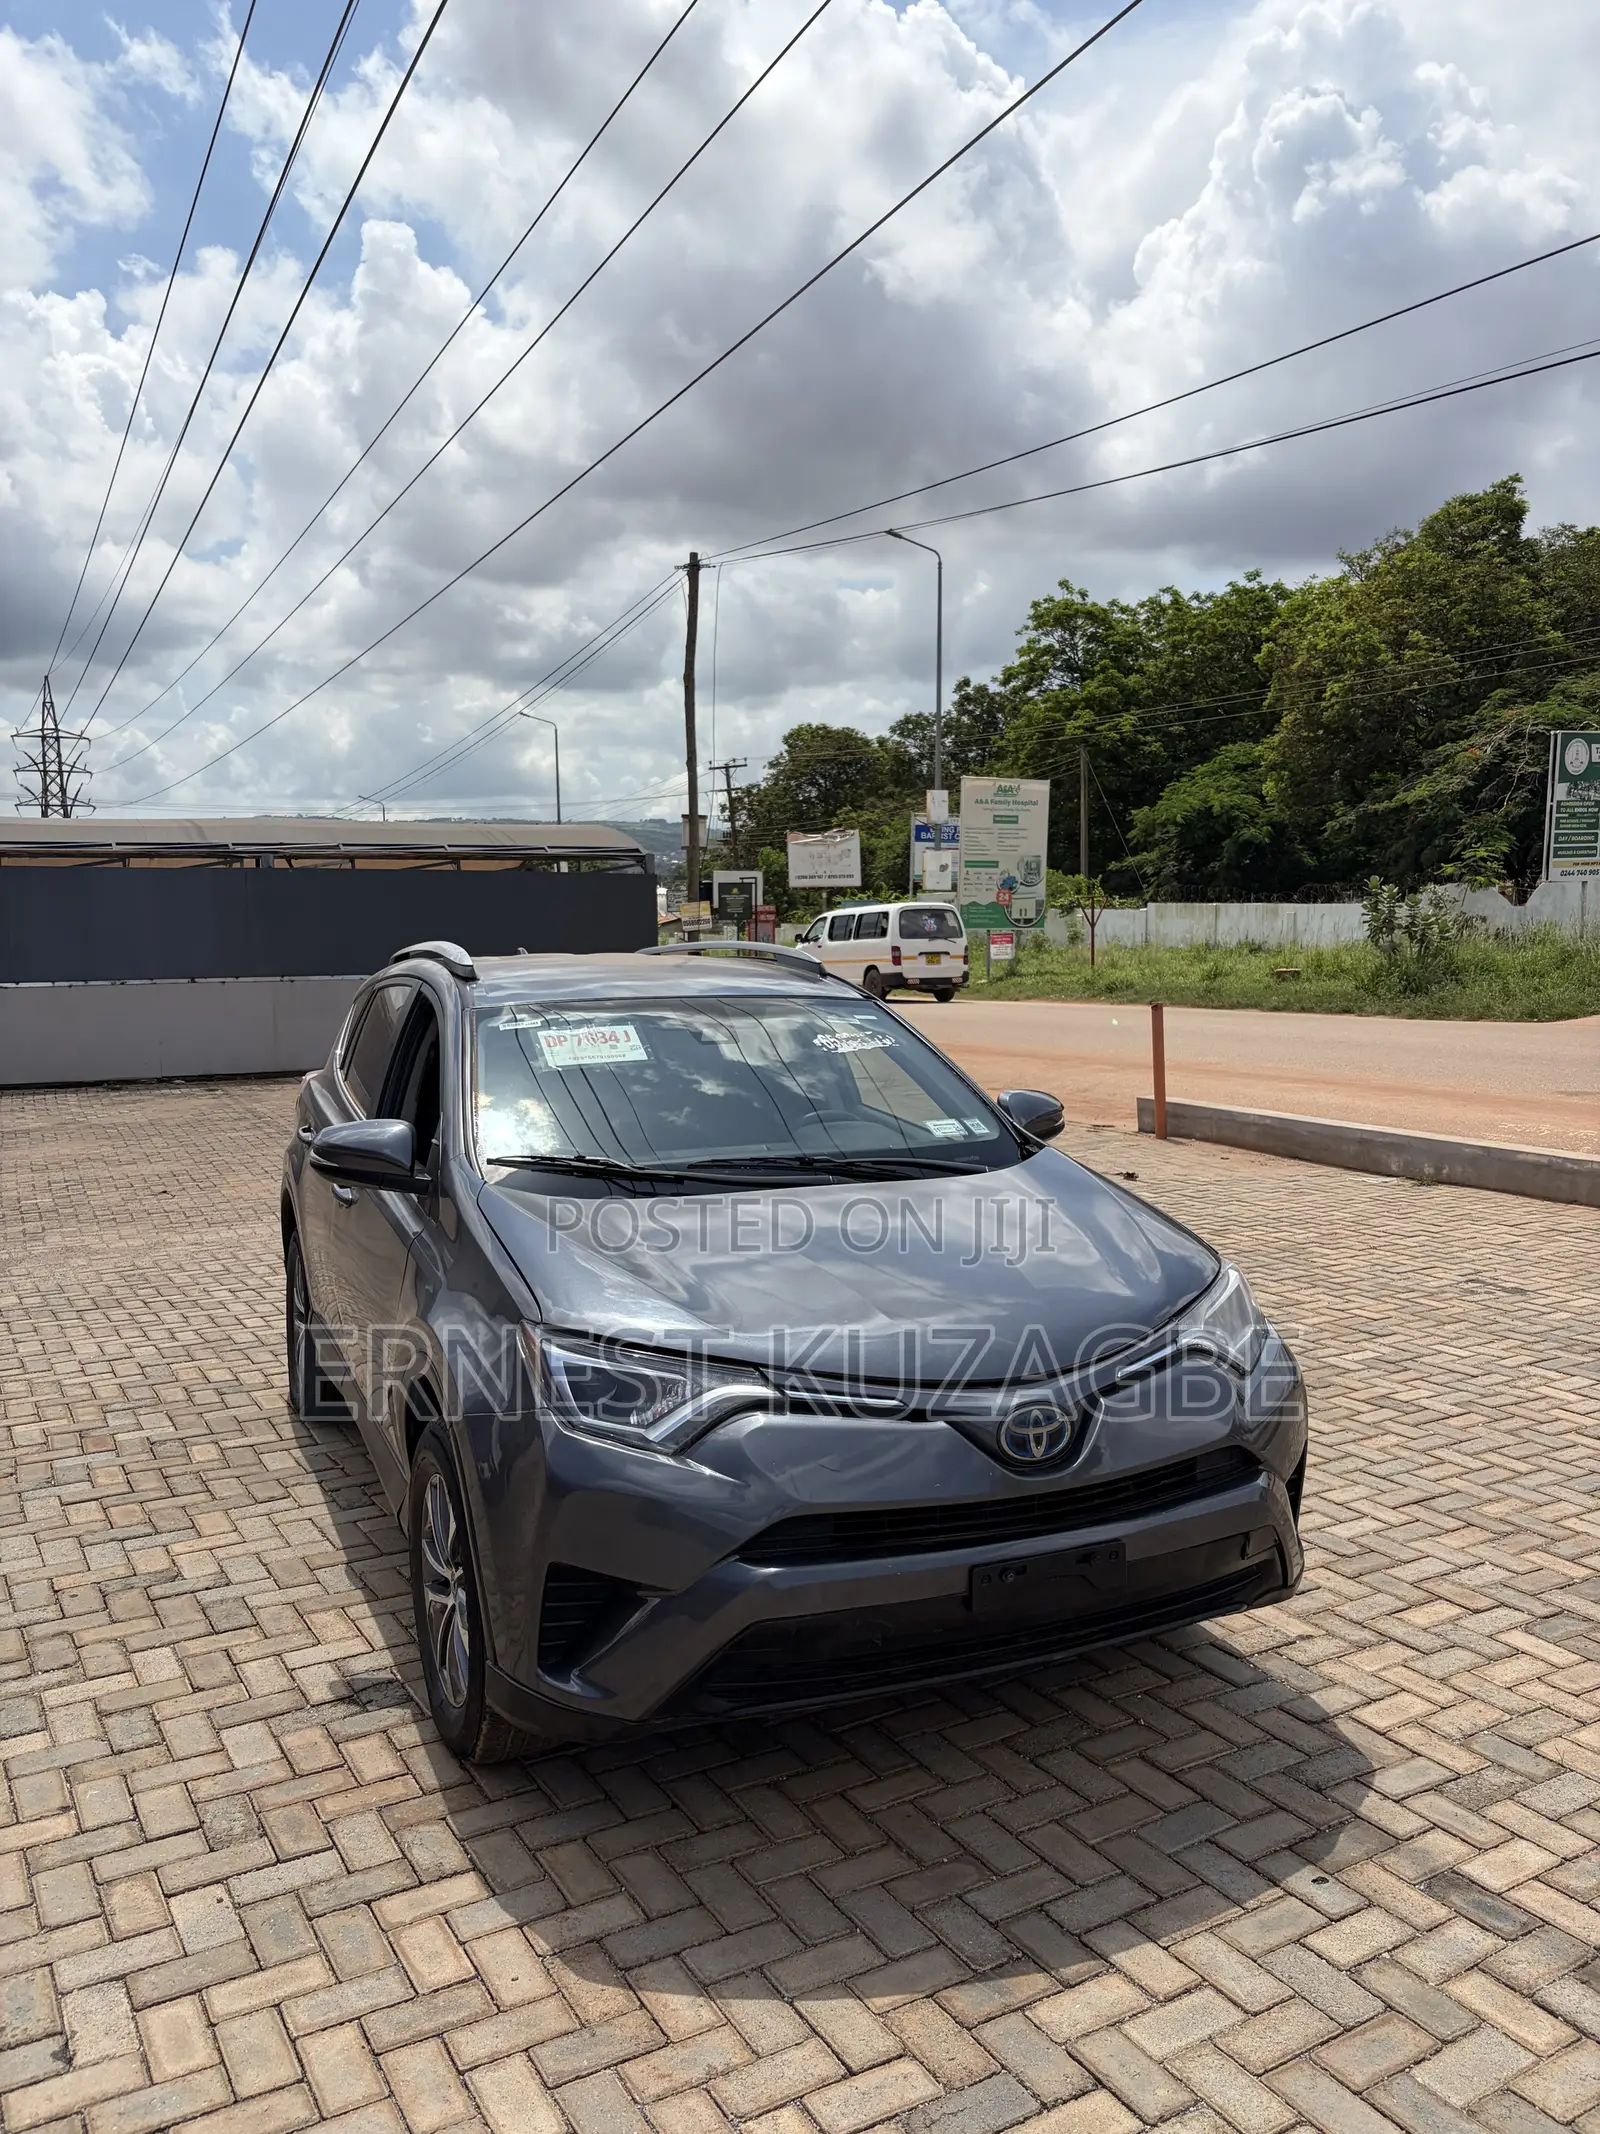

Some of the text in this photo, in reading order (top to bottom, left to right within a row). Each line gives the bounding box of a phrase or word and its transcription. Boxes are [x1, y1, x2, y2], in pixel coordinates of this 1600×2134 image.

[990, 799, 1011, 807] Family
[1012, 799, 1039, 807] Hospital
[1560, 869, 1576, 877] 0244
[999, 893, 1009, 901] 24
[544, 1034, 568, 1048] DP
